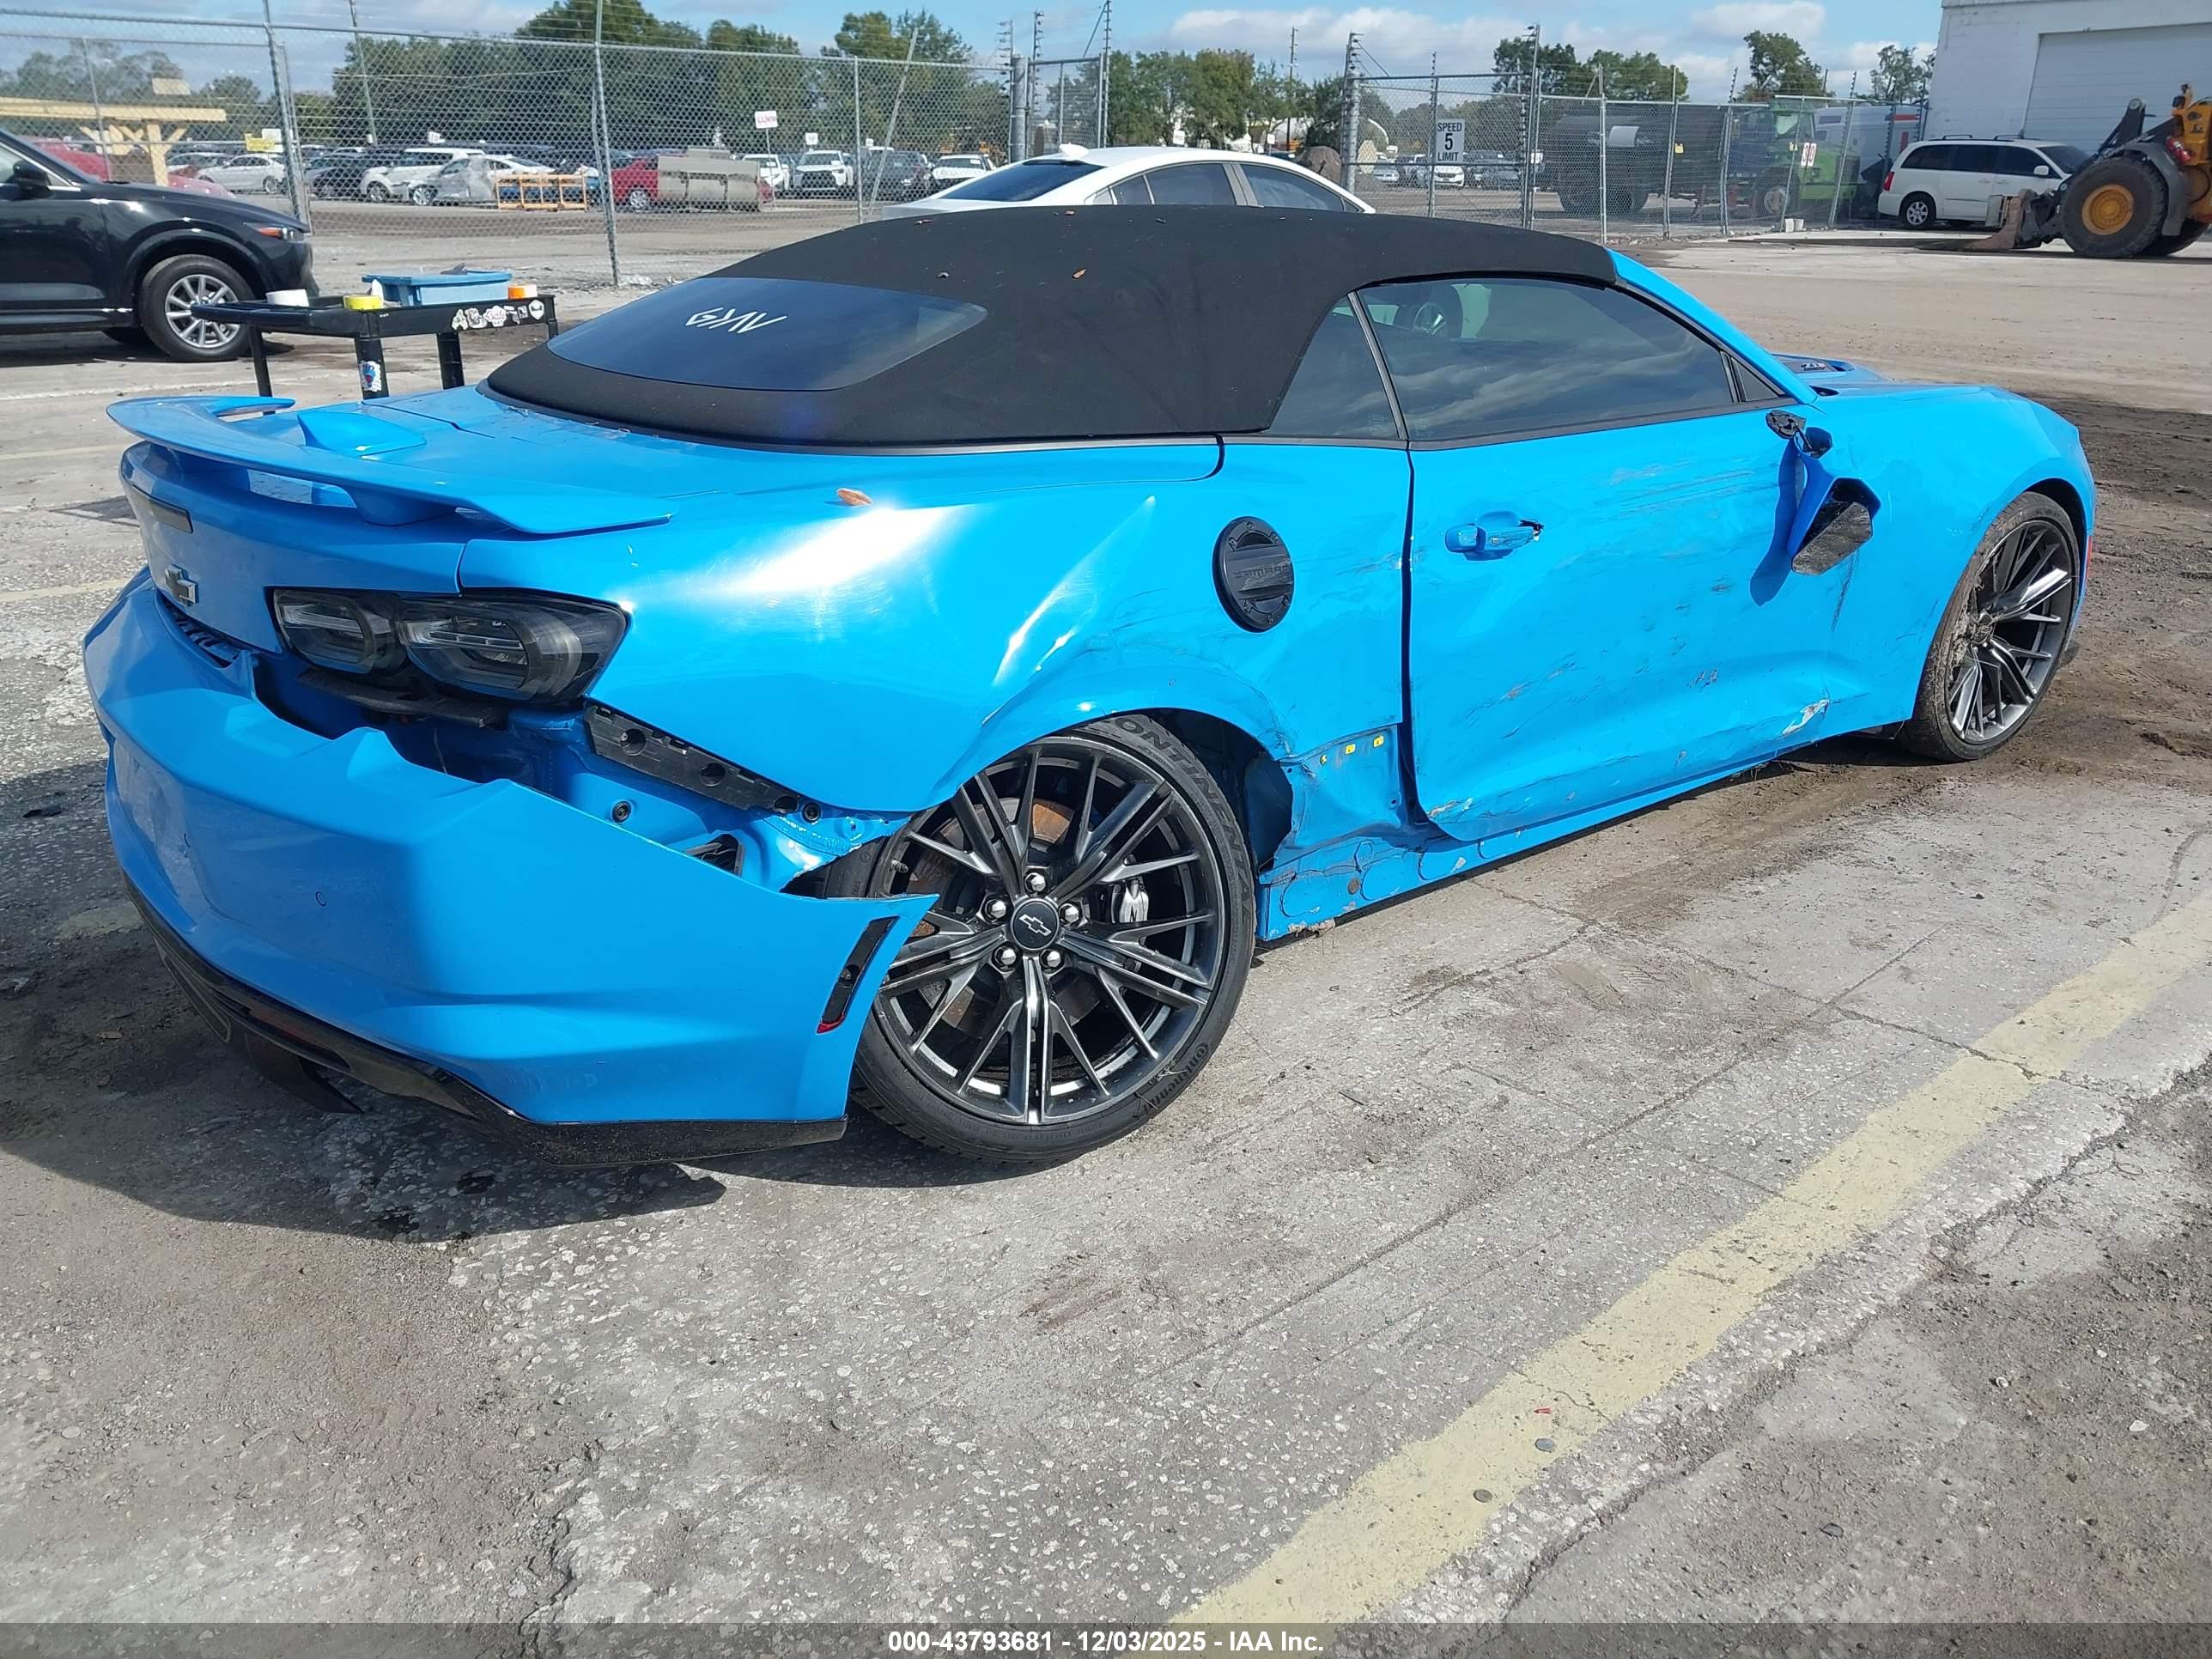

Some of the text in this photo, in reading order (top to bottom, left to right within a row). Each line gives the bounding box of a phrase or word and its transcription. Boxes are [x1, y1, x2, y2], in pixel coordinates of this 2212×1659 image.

[1437, 122, 1462, 131] SPEED
[1444, 132, 1454, 151] 5
[1437, 152, 1458, 161] LIMIT
